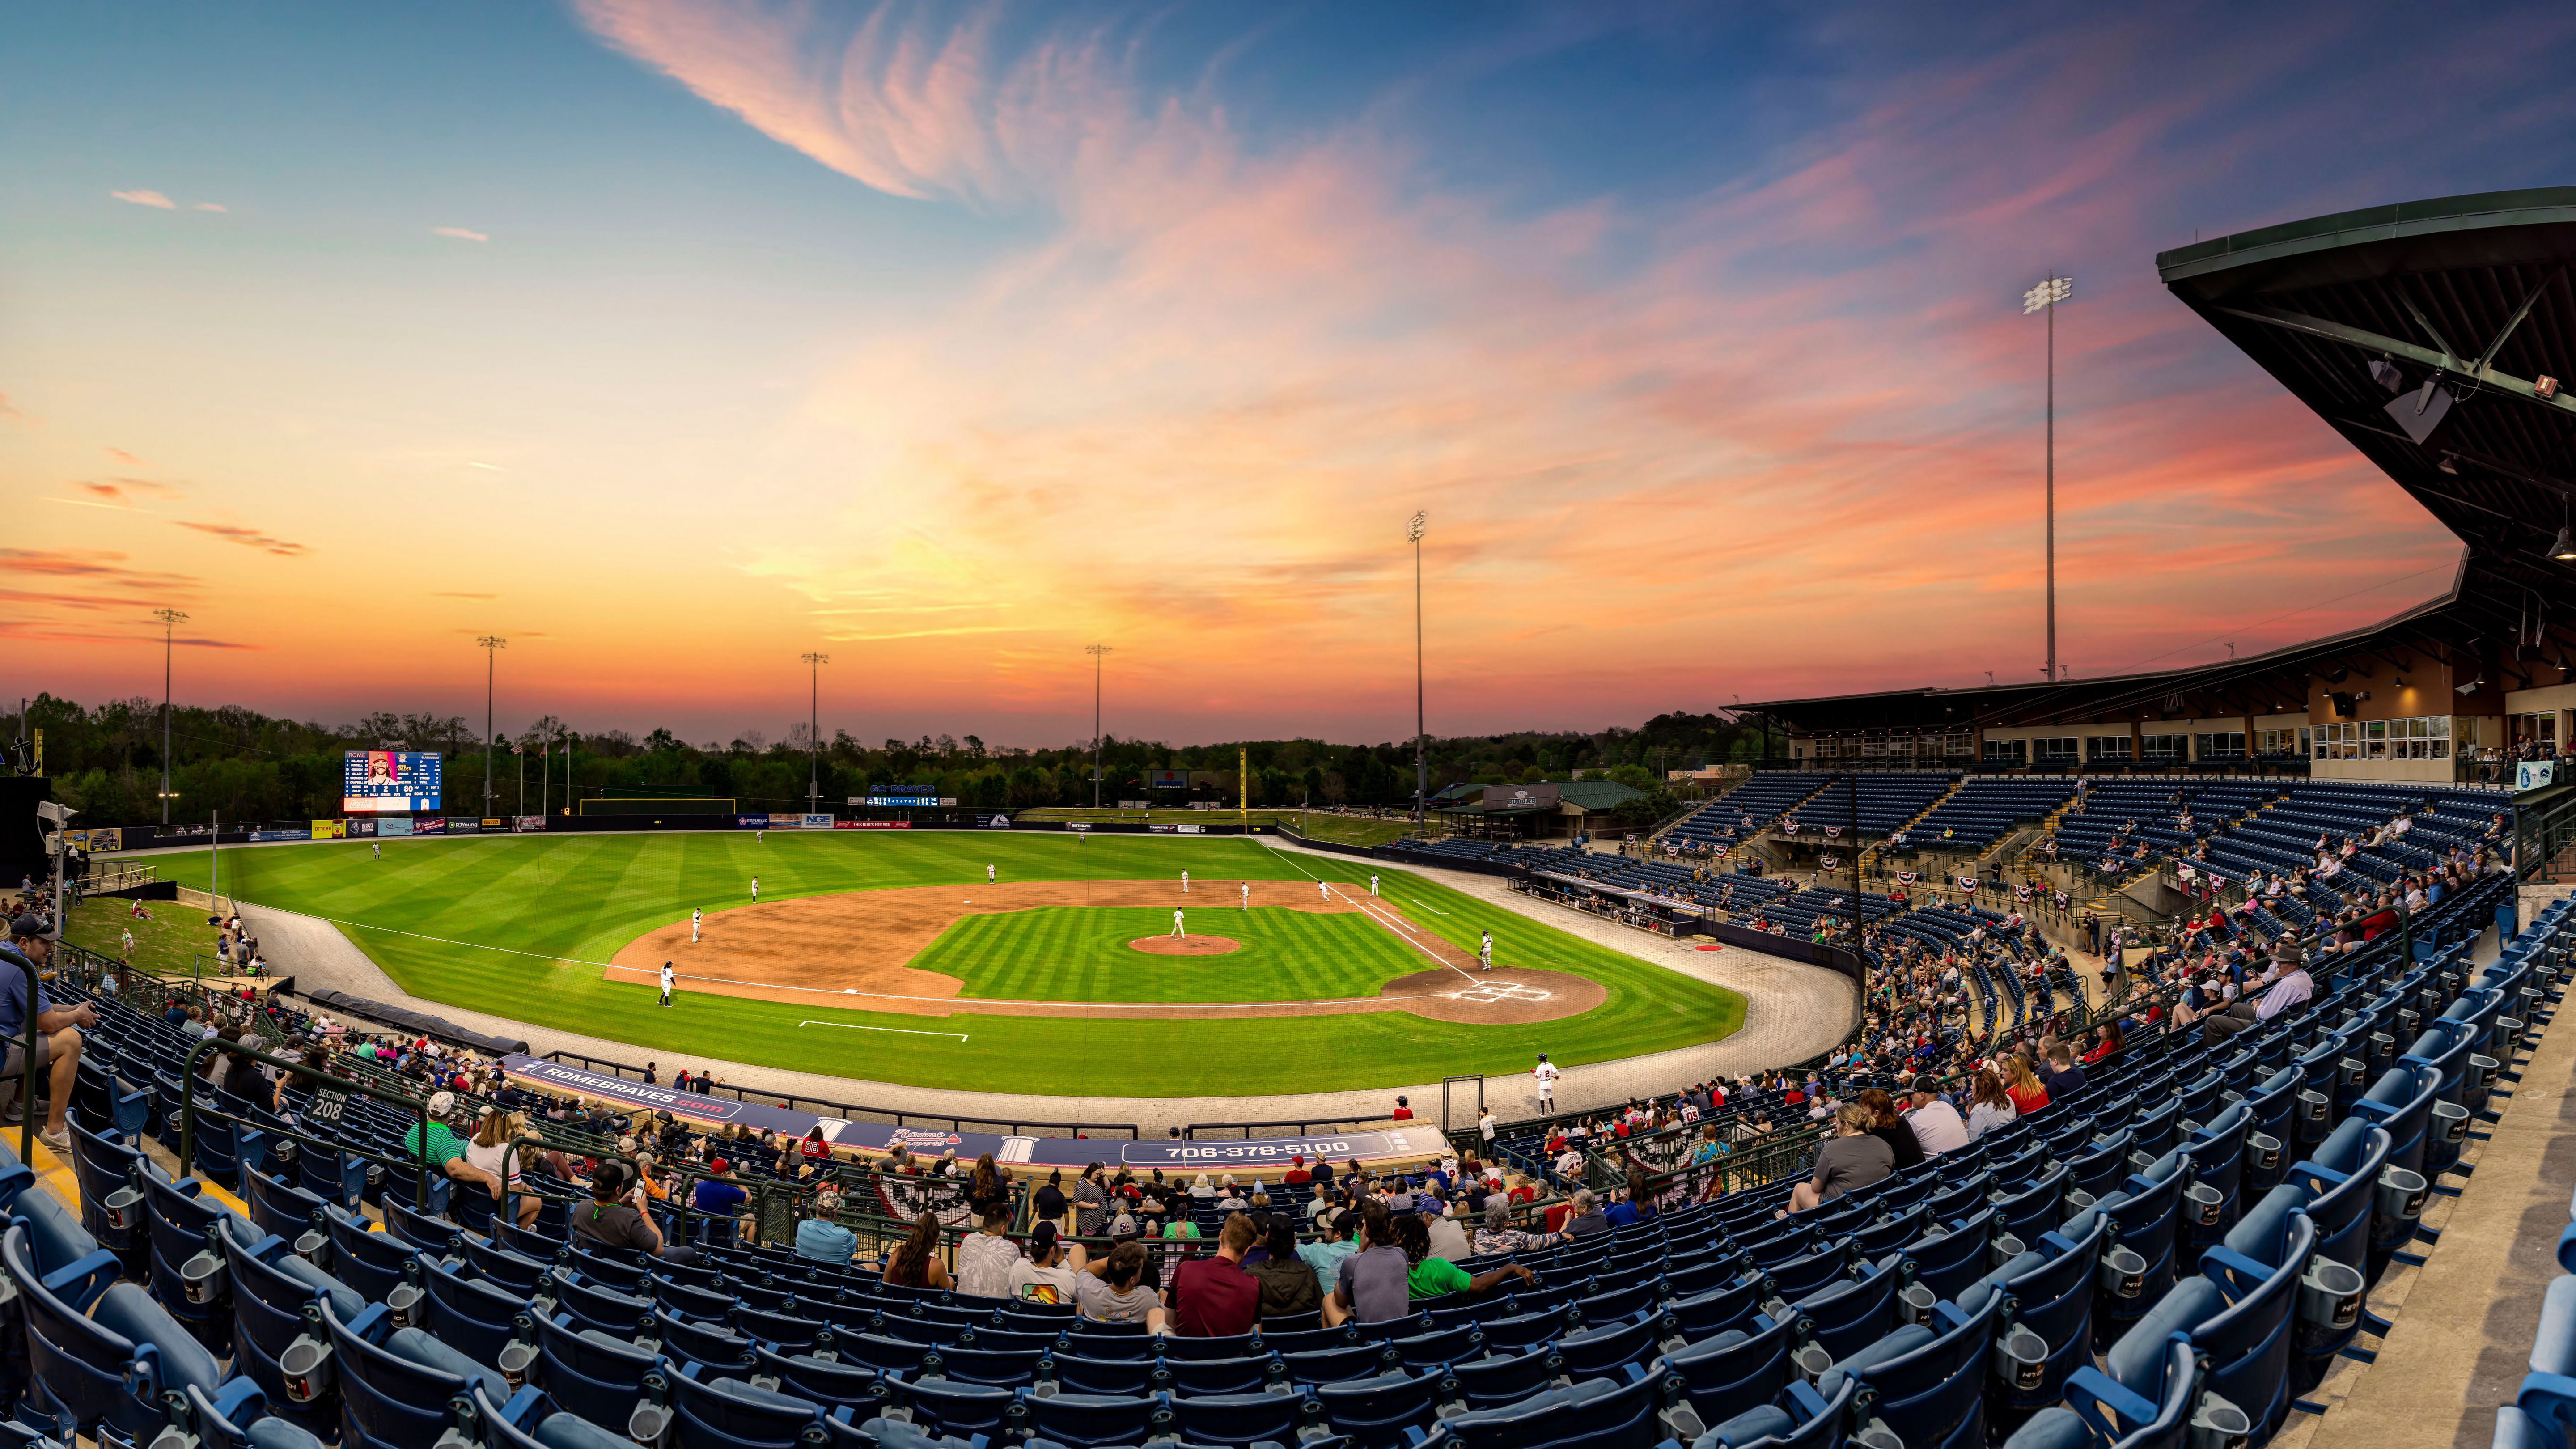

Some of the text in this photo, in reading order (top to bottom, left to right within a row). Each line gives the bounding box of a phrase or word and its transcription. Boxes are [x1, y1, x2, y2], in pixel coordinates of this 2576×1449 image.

[380, 738, 405, 750] Braves
[349, 799, 374, 809] Coca-Cola
[1545, 1070, 1550, 1078] 2
[318, 1088, 347, 1103] SECTION
[313, 1099, 343, 1120] 208
[1686, 1111, 1699, 1122] 05
[892, 1128, 946, 1138] Rome
[127, 1136, 134, 1144] 13
[805, 1141, 819, 1153] 58
[1166, 1142, 1350, 1158] 706-378-5100
[1568, 1155, 1581, 1163] COFFMAN
[1348, 1177, 1358, 1185] MARK
[1120, 1222, 1130, 1233] 21
